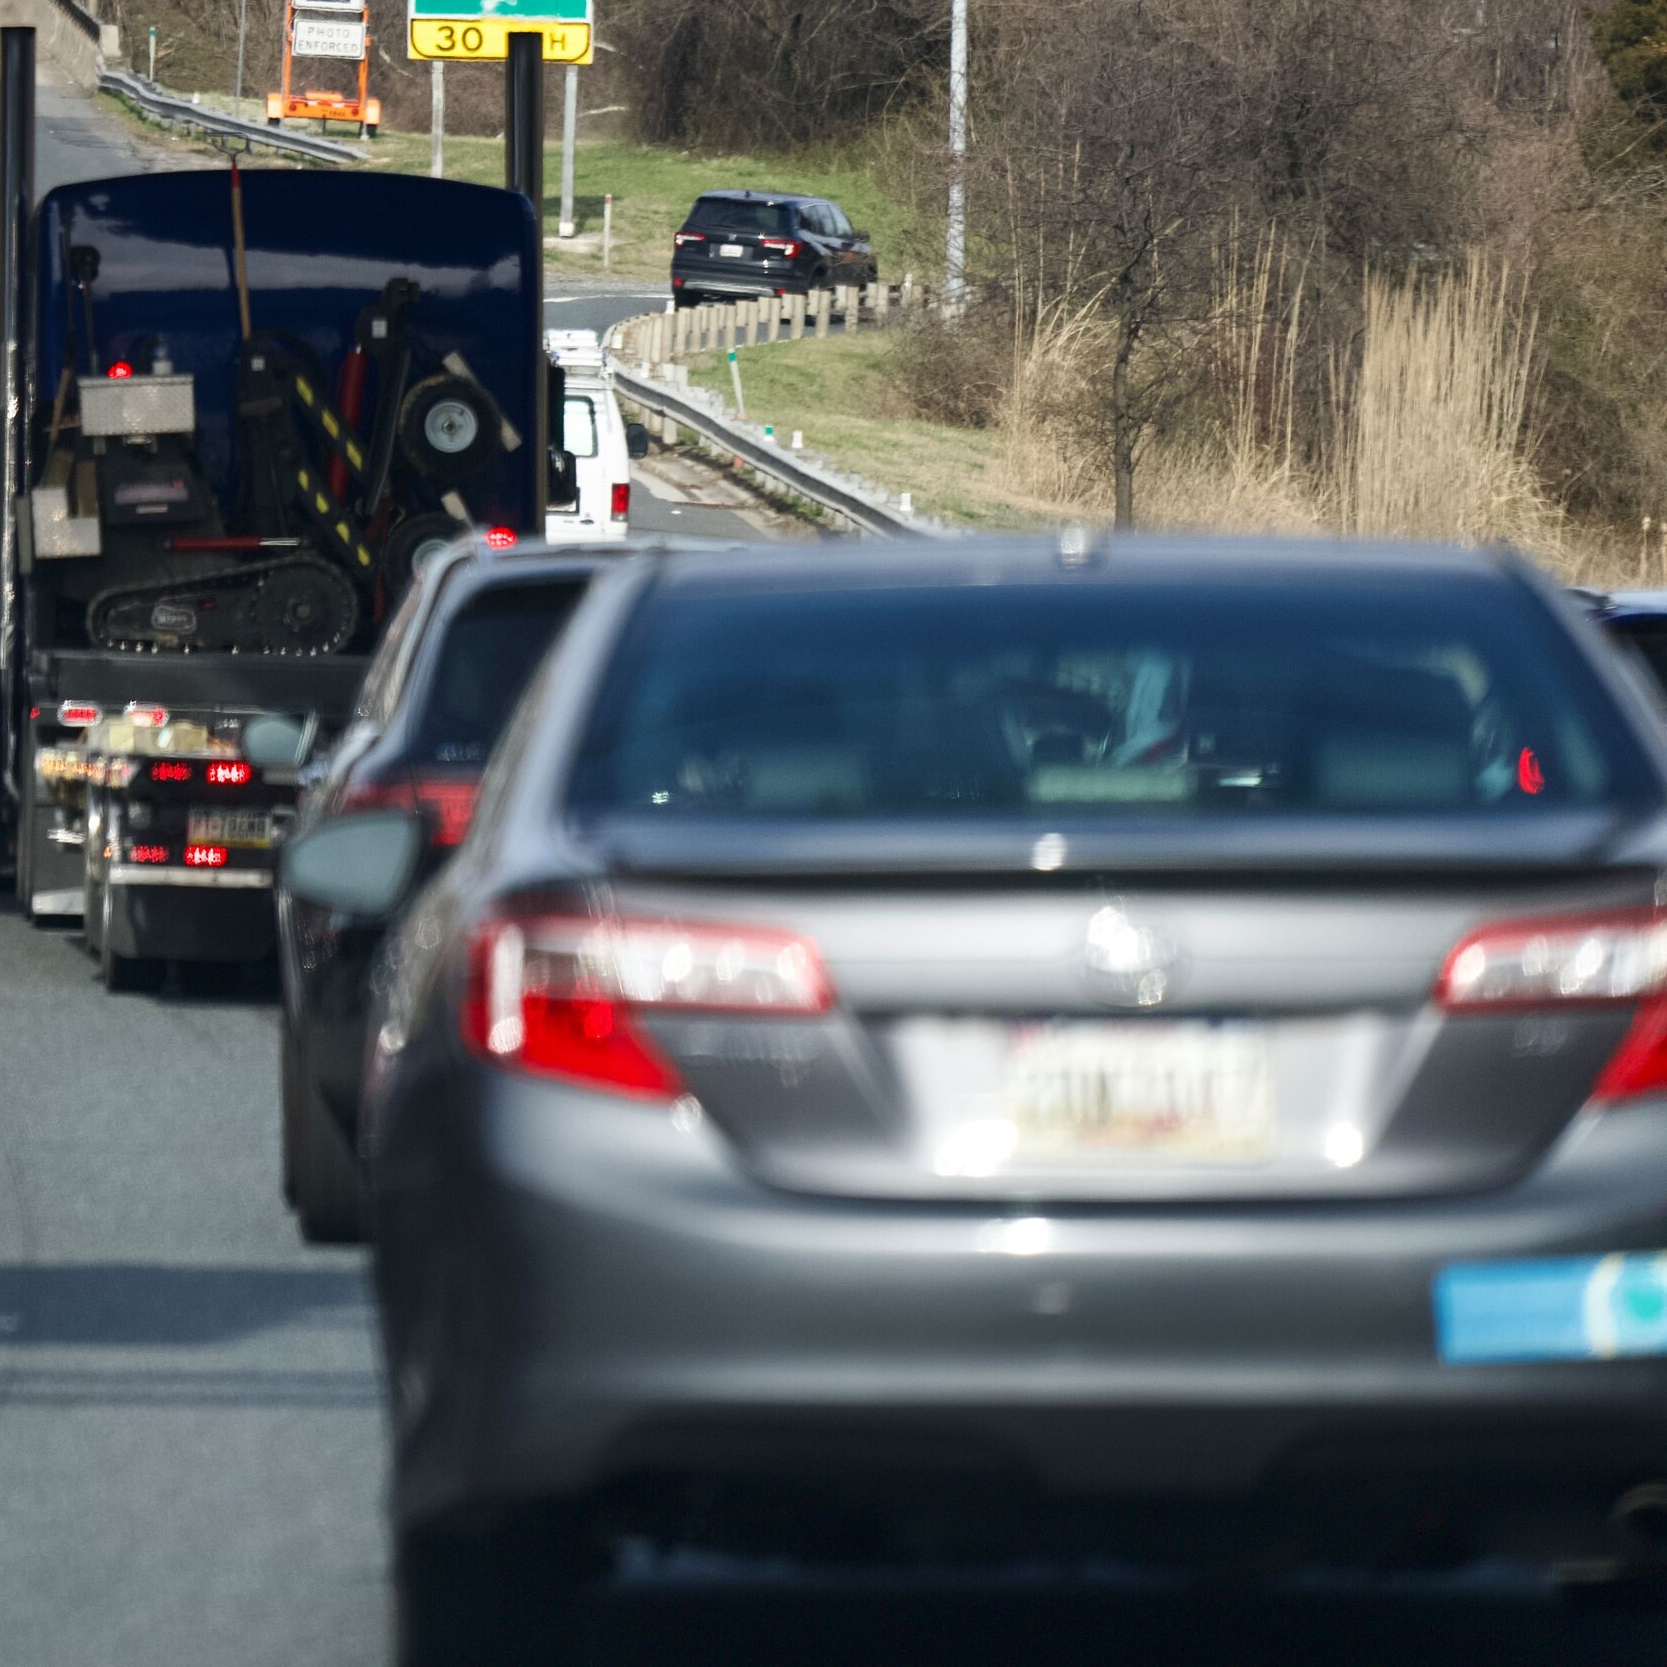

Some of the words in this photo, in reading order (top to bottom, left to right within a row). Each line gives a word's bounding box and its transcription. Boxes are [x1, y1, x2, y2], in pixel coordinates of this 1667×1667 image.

[307, 26, 350, 38] PHOTO
[436, 26, 483, 52] 30
[298, 40, 358, 53] ENFORCED
